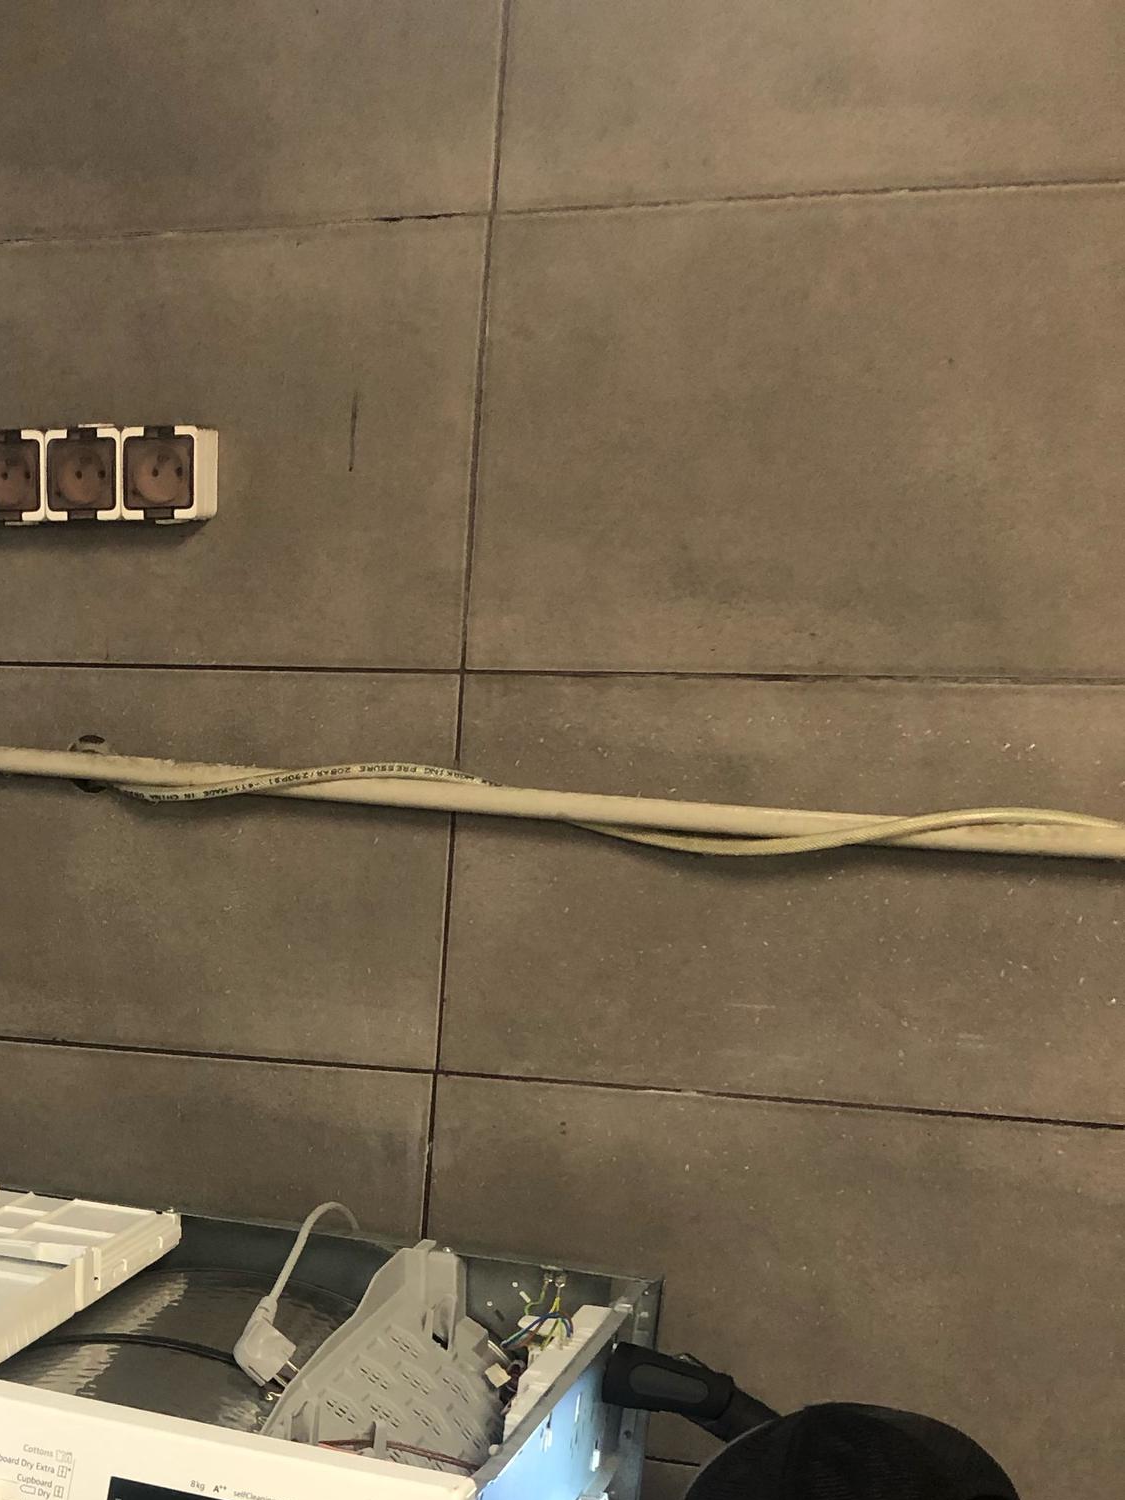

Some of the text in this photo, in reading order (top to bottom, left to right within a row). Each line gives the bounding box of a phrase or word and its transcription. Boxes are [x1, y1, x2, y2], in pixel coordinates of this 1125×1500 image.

[358, 764, 417, 774] PRESSURE
[23, 1443, 53, 1457] Cottons
[19, 1459, 34, 1471] Dry
[35, 1462, 55, 1474] Extra
[17, 1473, 52, 1489] Cupboard
[37, 1488, 51, 1500] Dry
